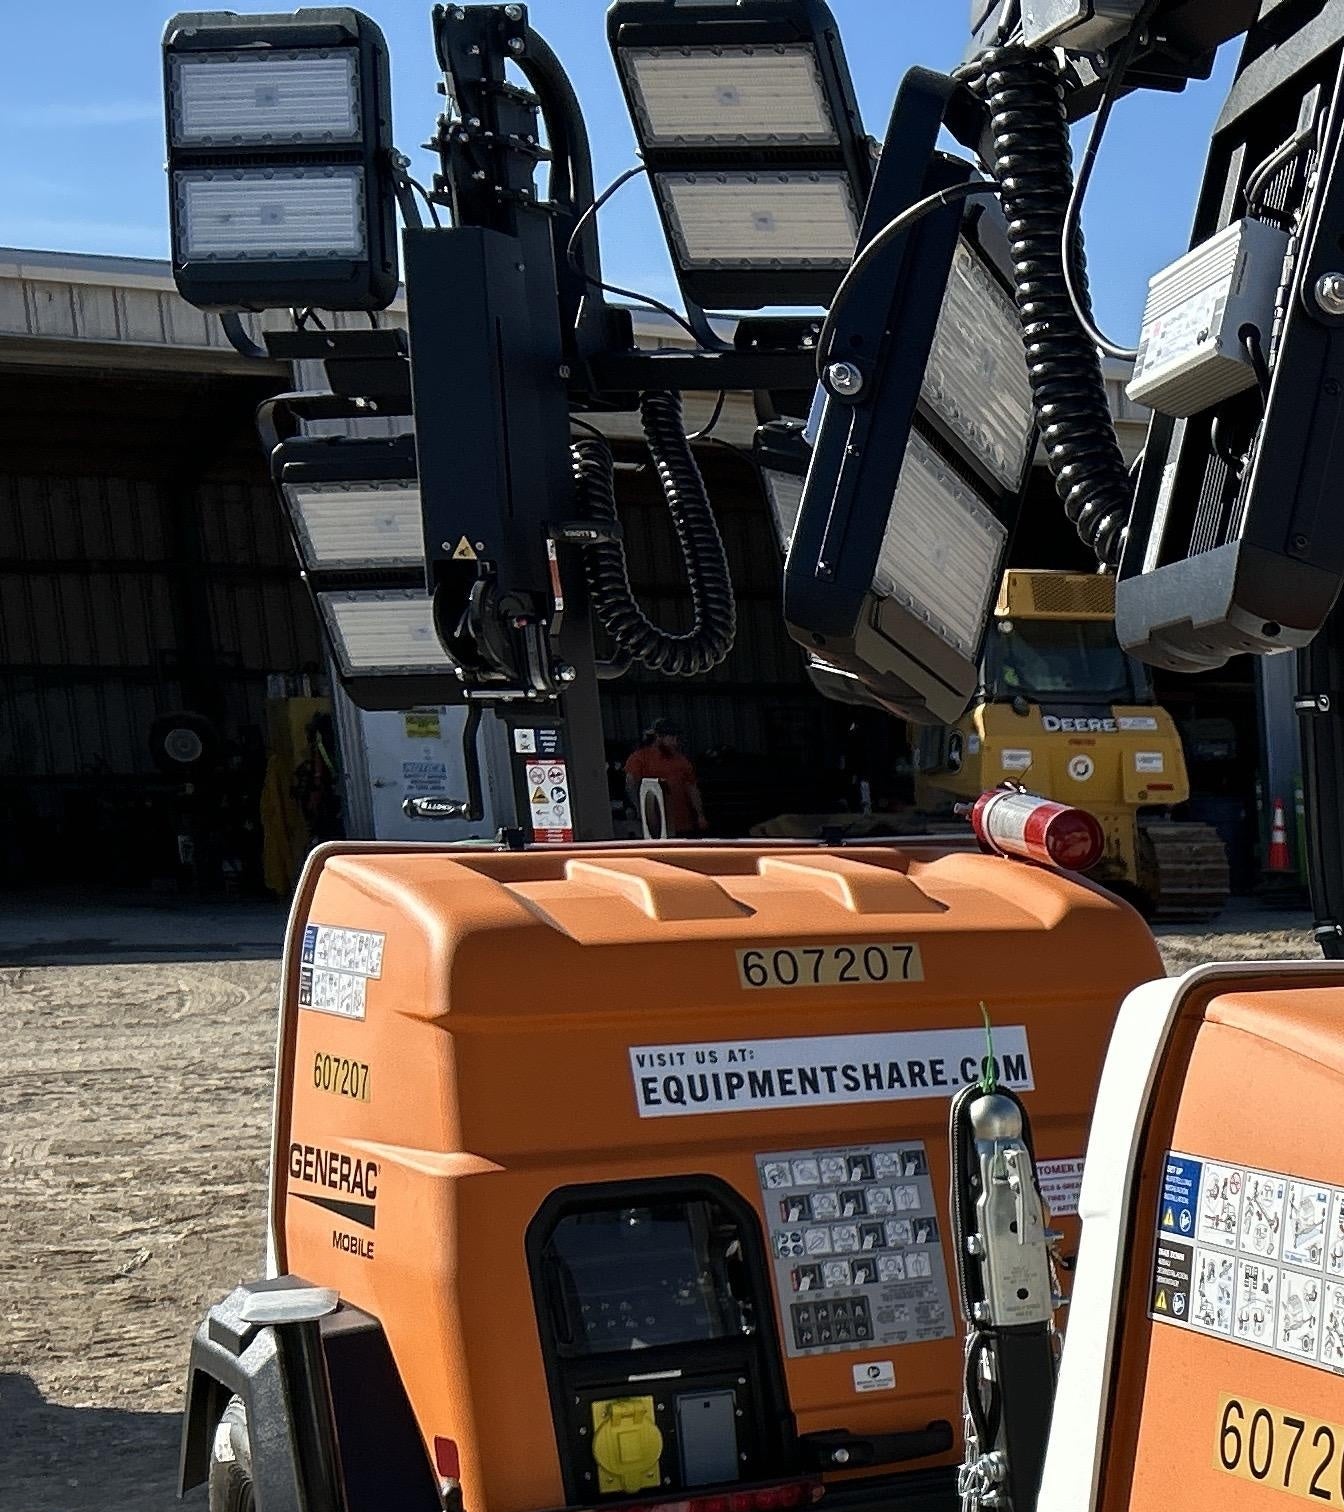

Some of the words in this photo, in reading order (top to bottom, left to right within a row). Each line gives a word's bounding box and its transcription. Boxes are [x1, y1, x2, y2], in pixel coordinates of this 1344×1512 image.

[1041, 715, 1119, 732] DEERE
[742, 945, 914, 987] 607207
[313, 1052, 369, 1101] 607207
[636, 1051, 686, 1068] VISIT
[695, 1049, 718, 1065] US
[728, 1047, 756, 1064] AT:
[641, 1053, 1029, 1106] EQUIPMENTSHARE.COM
[288, 1142, 379, 1199] GENERAC
[333, 1230, 375, 1259] MOBILE
